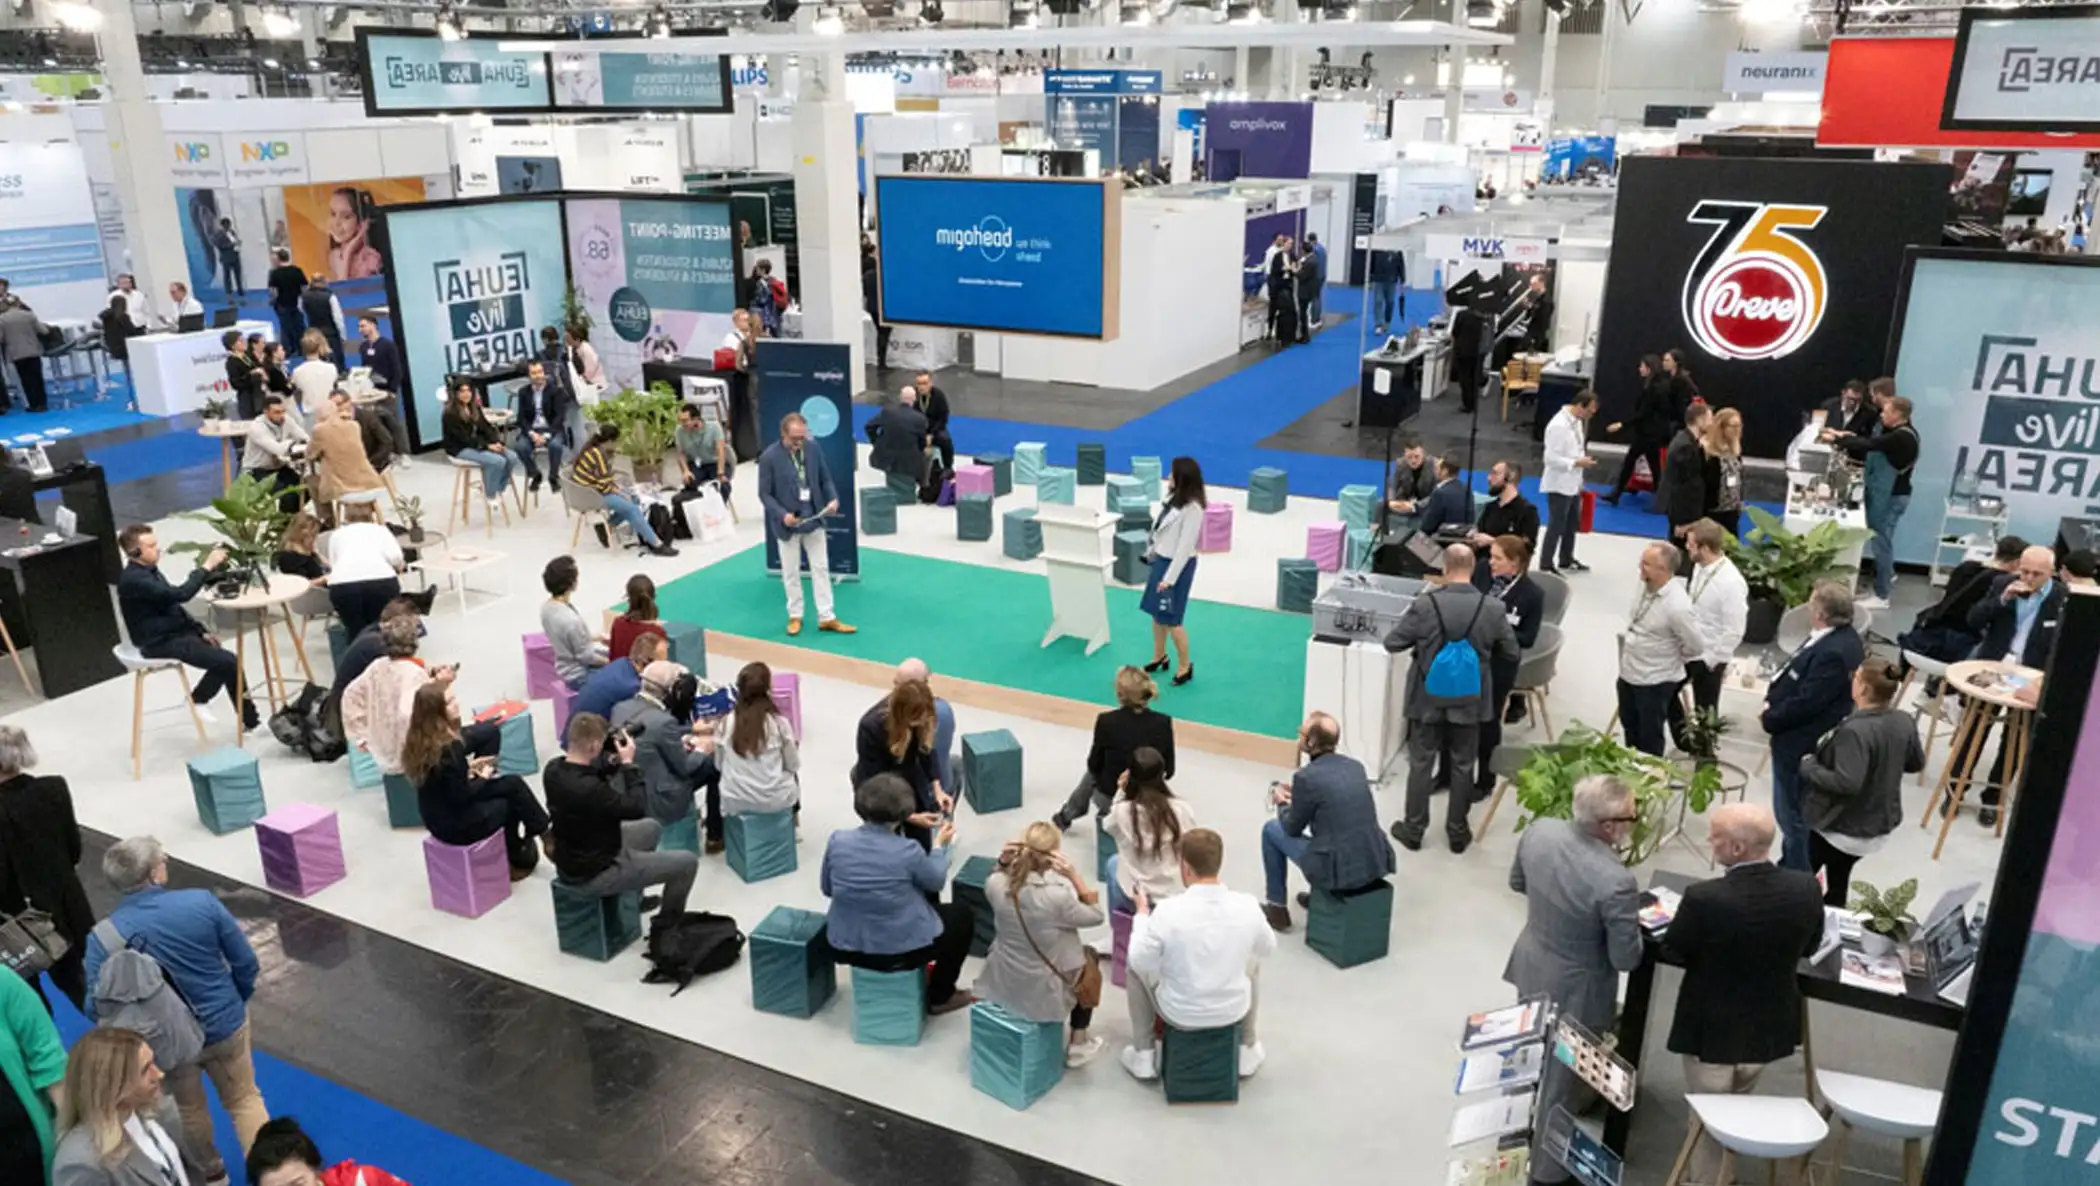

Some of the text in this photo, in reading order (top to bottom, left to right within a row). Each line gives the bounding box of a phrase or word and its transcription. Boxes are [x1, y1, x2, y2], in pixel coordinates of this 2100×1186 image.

[1741, 66, 1817, 79] neuranix
[1229, 117, 1286, 131] amplivox
[174, 142, 209, 163] NXP
[241, 141, 289, 162] NXP
[936, 224, 1012, 251] migohead
[1463, 238, 1504, 252] MVK
[1682, 199, 1828, 360] 75
